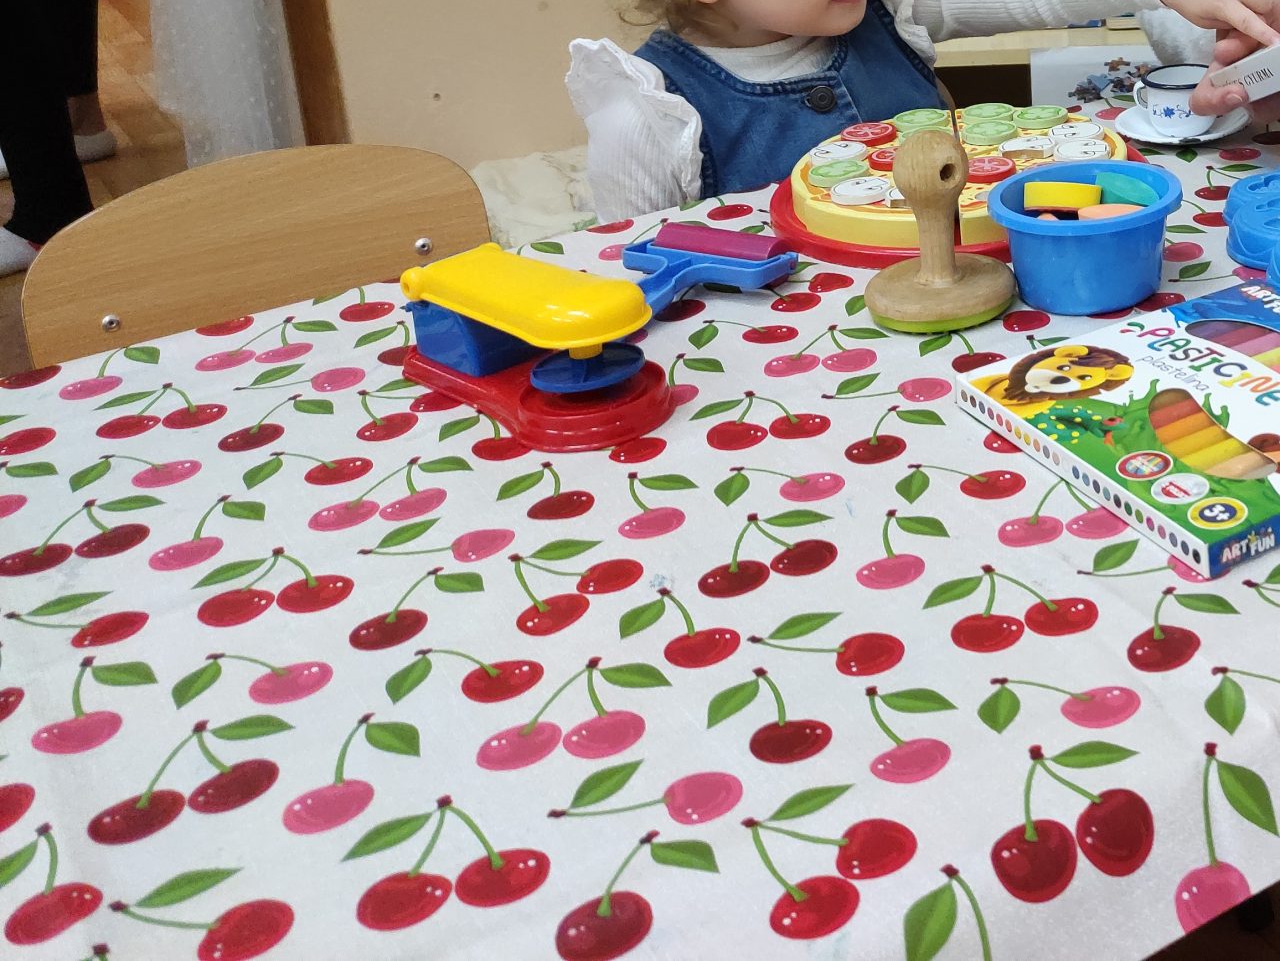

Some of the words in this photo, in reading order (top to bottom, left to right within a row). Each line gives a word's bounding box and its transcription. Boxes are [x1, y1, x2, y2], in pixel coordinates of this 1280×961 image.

[1243, 67, 1274, 87] GYURMA
[1240, 286, 1280, 302] ART
[1135, 355, 1210, 391] plastelina
[1203, 503, 1230, 521] 3+
[1221, 542, 1247, 562] ART
[1250, 533, 1275, 556] FUN
